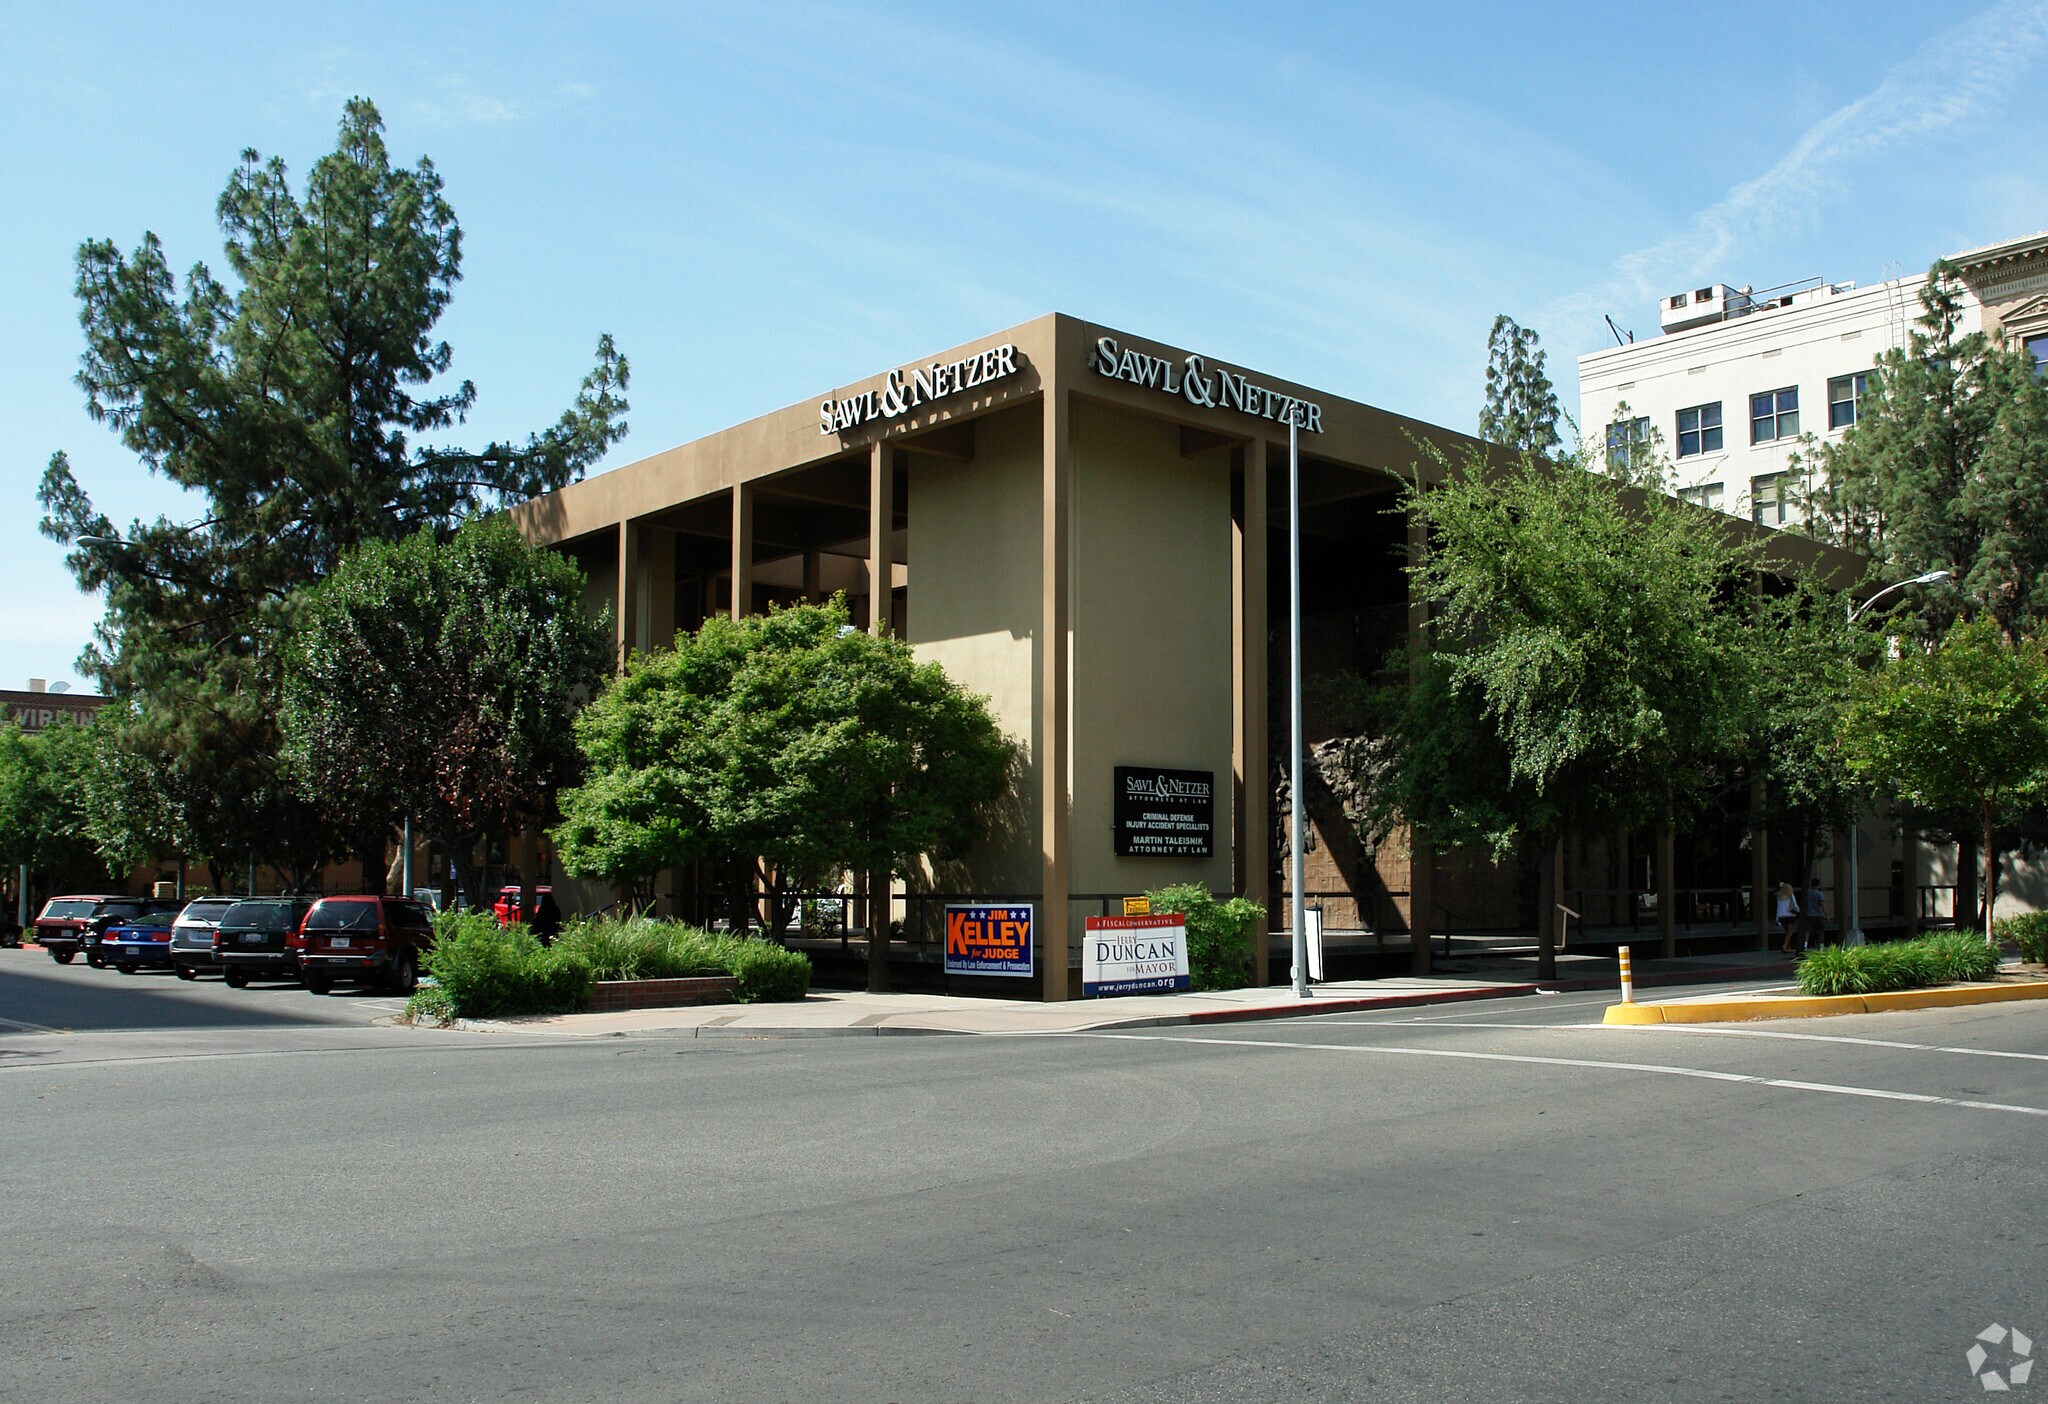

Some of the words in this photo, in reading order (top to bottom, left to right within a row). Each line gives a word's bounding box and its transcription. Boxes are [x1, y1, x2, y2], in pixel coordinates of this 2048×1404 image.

[820, 390, 880, 436] SAWL
[881, 368, 912, 418] &
[911, 343, 1018, 407] NETZER
[1097, 336, 1180, 394] SAWL
[1182, 354, 1216, 408] &
[1216, 368, 1324, 434] NETZER
[1126, 776, 1155, 792] SAWL
[1156, 775, 1170, 797] &
[1169, 778, 1210, 795] NETZER
[1129, 795, 1174, 803] ATTORNEYS
[1142, 812, 1169, 821] CRIMINAL
[1170, 813, 1194, 822] DEFENSE
[1126, 820, 1147, 829] INJURY
[1147, 821, 1175, 830] ACCIDENT
[1176, 822, 1210, 831] SPECIALISTS
[1133, 836, 1163, 844] MARTIN
[1164, 836, 1204, 845] TALEISNIK
[1129, 845, 1173, 853] ATTORNEY
[987, 910, 1008, 920] JIM
[1103, 919, 1126, 927] FISCAL
[1126, 919, 1174, 927] CONSERVATIVE
[947, 912, 1030, 955] KELLEY
[1117, 936, 1137, 945] JERRY
[970, 948, 982, 960] for
[982, 948, 1020, 960] JUDGE
[1096, 942, 1175, 962] DUNCAN
[1135, 962, 1176, 974] MAYOR
[1098, 977, 1175, 992] www.jerryduncan.org
